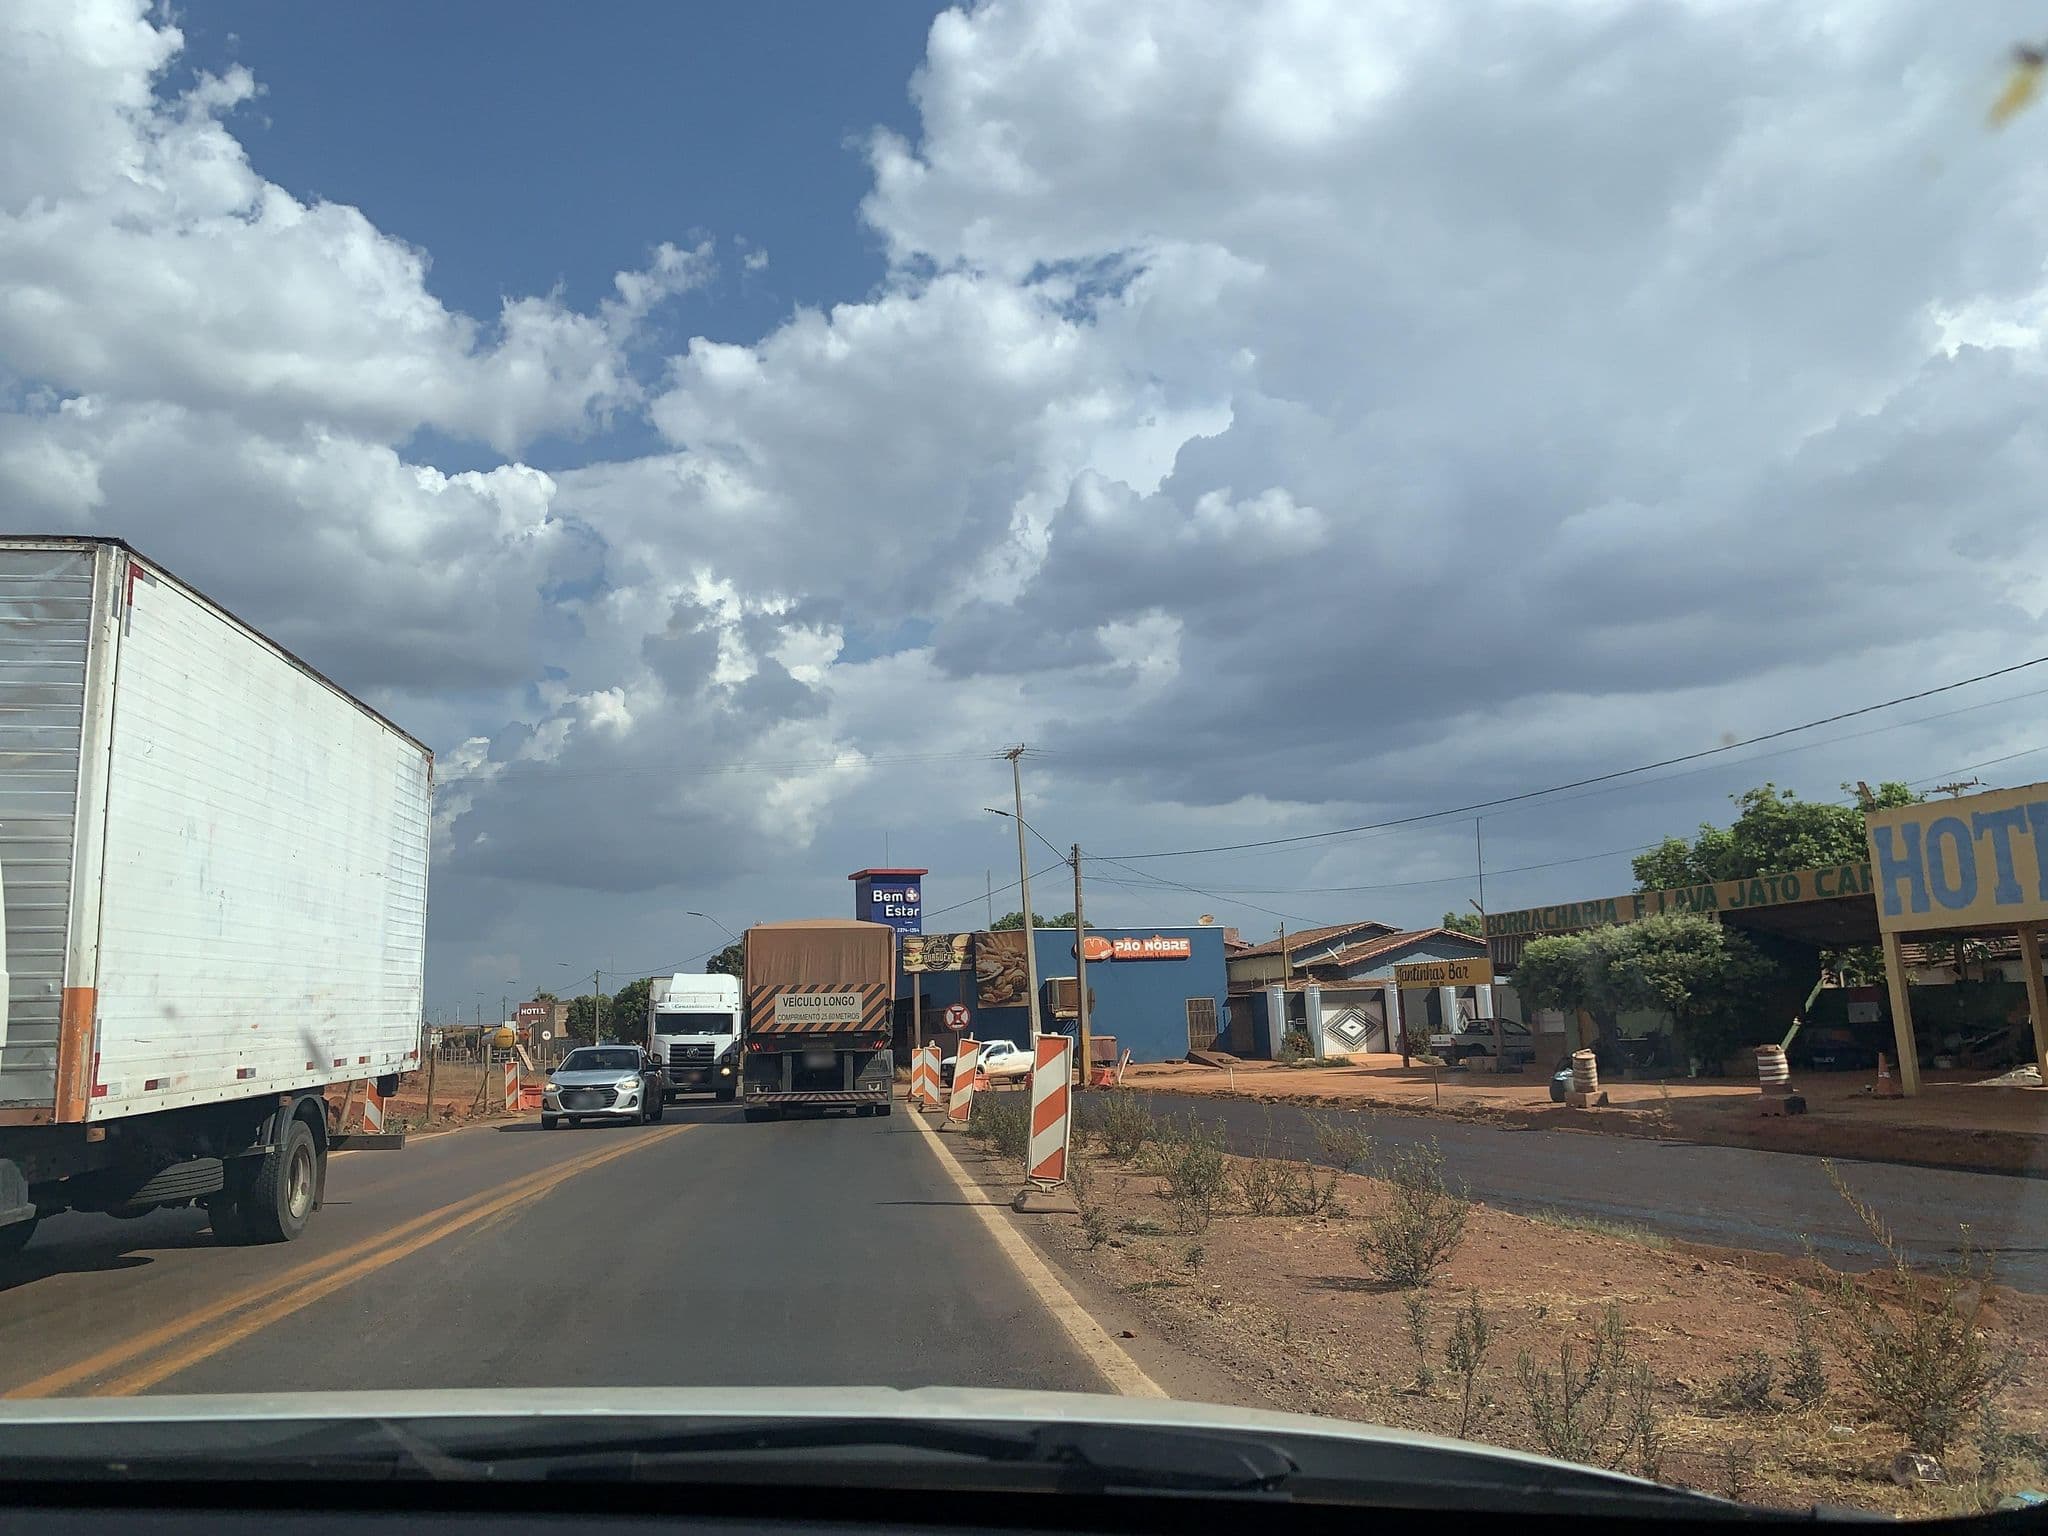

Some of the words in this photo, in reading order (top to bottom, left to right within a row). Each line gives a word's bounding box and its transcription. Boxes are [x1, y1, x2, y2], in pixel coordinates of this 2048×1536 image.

[873, 890, 903, 902] Bem
[1728, 873, 1800, 908] JATO
[885, 904, 920, 917] Estar
[1448, 962, 1469, 980] Bar
[823, 996, 855, 1007] LONGO
